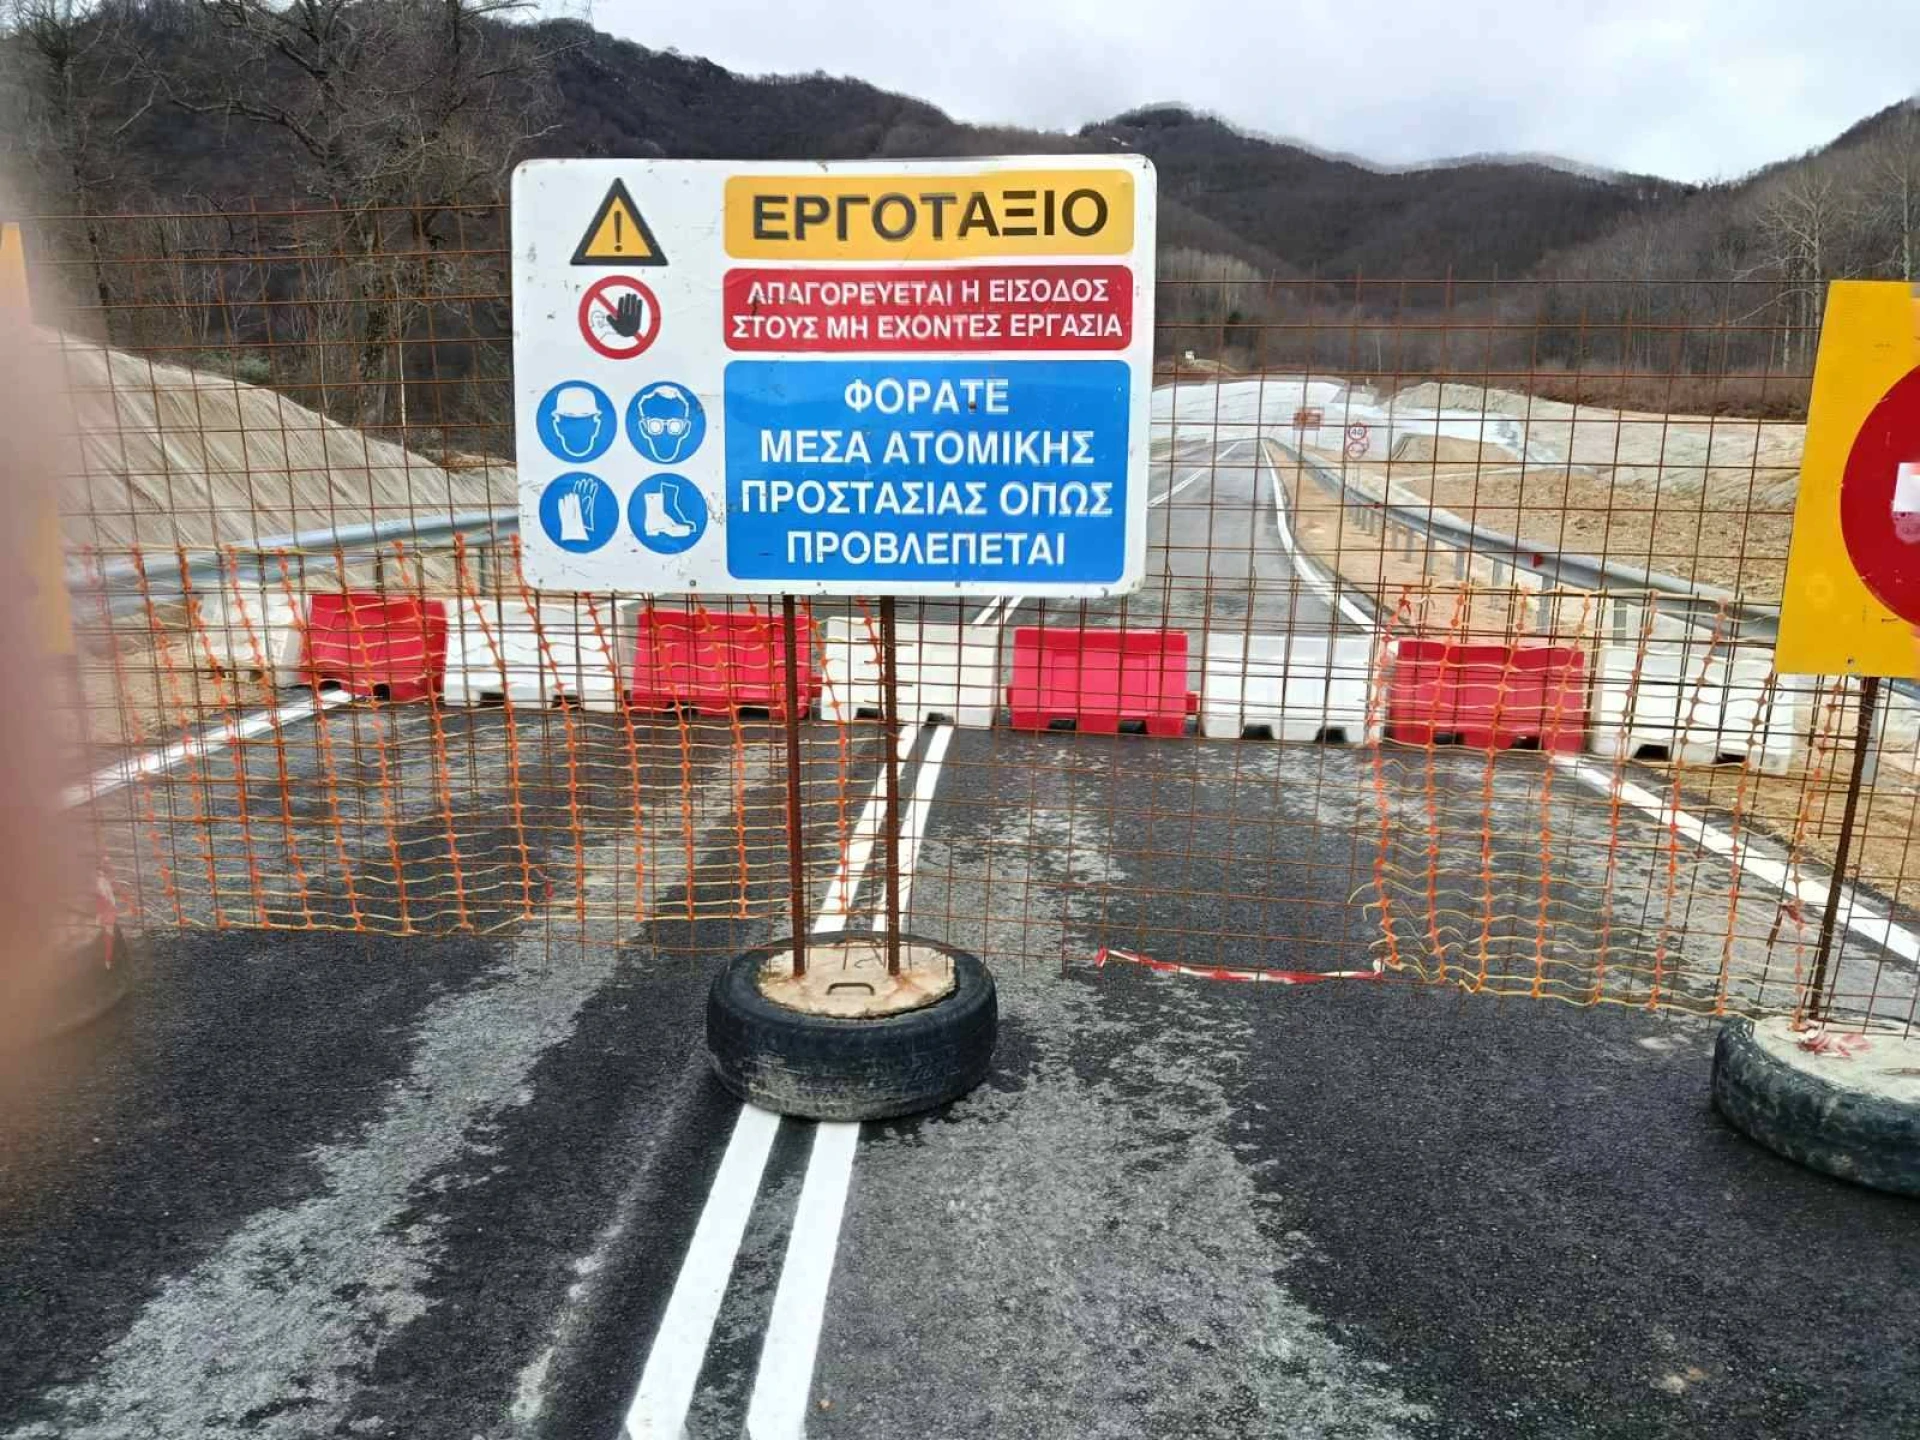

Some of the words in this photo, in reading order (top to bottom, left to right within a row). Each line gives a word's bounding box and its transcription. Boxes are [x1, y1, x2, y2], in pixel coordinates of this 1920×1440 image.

[753, 188, 1108, 241] ΕΡΓΟΤΑΞΙΟ
[747, 280, 953, 305] ΑΠΑΓΟΡΕΥΕΤΑΙ
[961, 280, 980, 303] Η
[989, 279, 1109, 302] ΕΙΣΟΔΟΣ
[732, 315, 819, 339] ΣΤΟΥΣ
[827, 315, 868, 339] ΜΗ
[878, 314, 1002, 339] ΕΧΟΝΤΕΣ
[1010, 313, 1123, 337] ΕΡΓΑΣΙΑ
[844, 378, 1009, 414] ΦΟΡΑΤΕ
[760, 430, 871, 463] ΜΕΣΑ
[883, 430, 1095, 466] ΑΤΟΜΙΚΗΣ
[741, 480, 988, 515] ΠΡΟΣΤΑΣΙΑΣ
[999, 481, 1113, 517] ΟΠΩΣ
[786, 530, 1065, 566] ΠΡΟΒΛΕΠΕΤΑΙ
